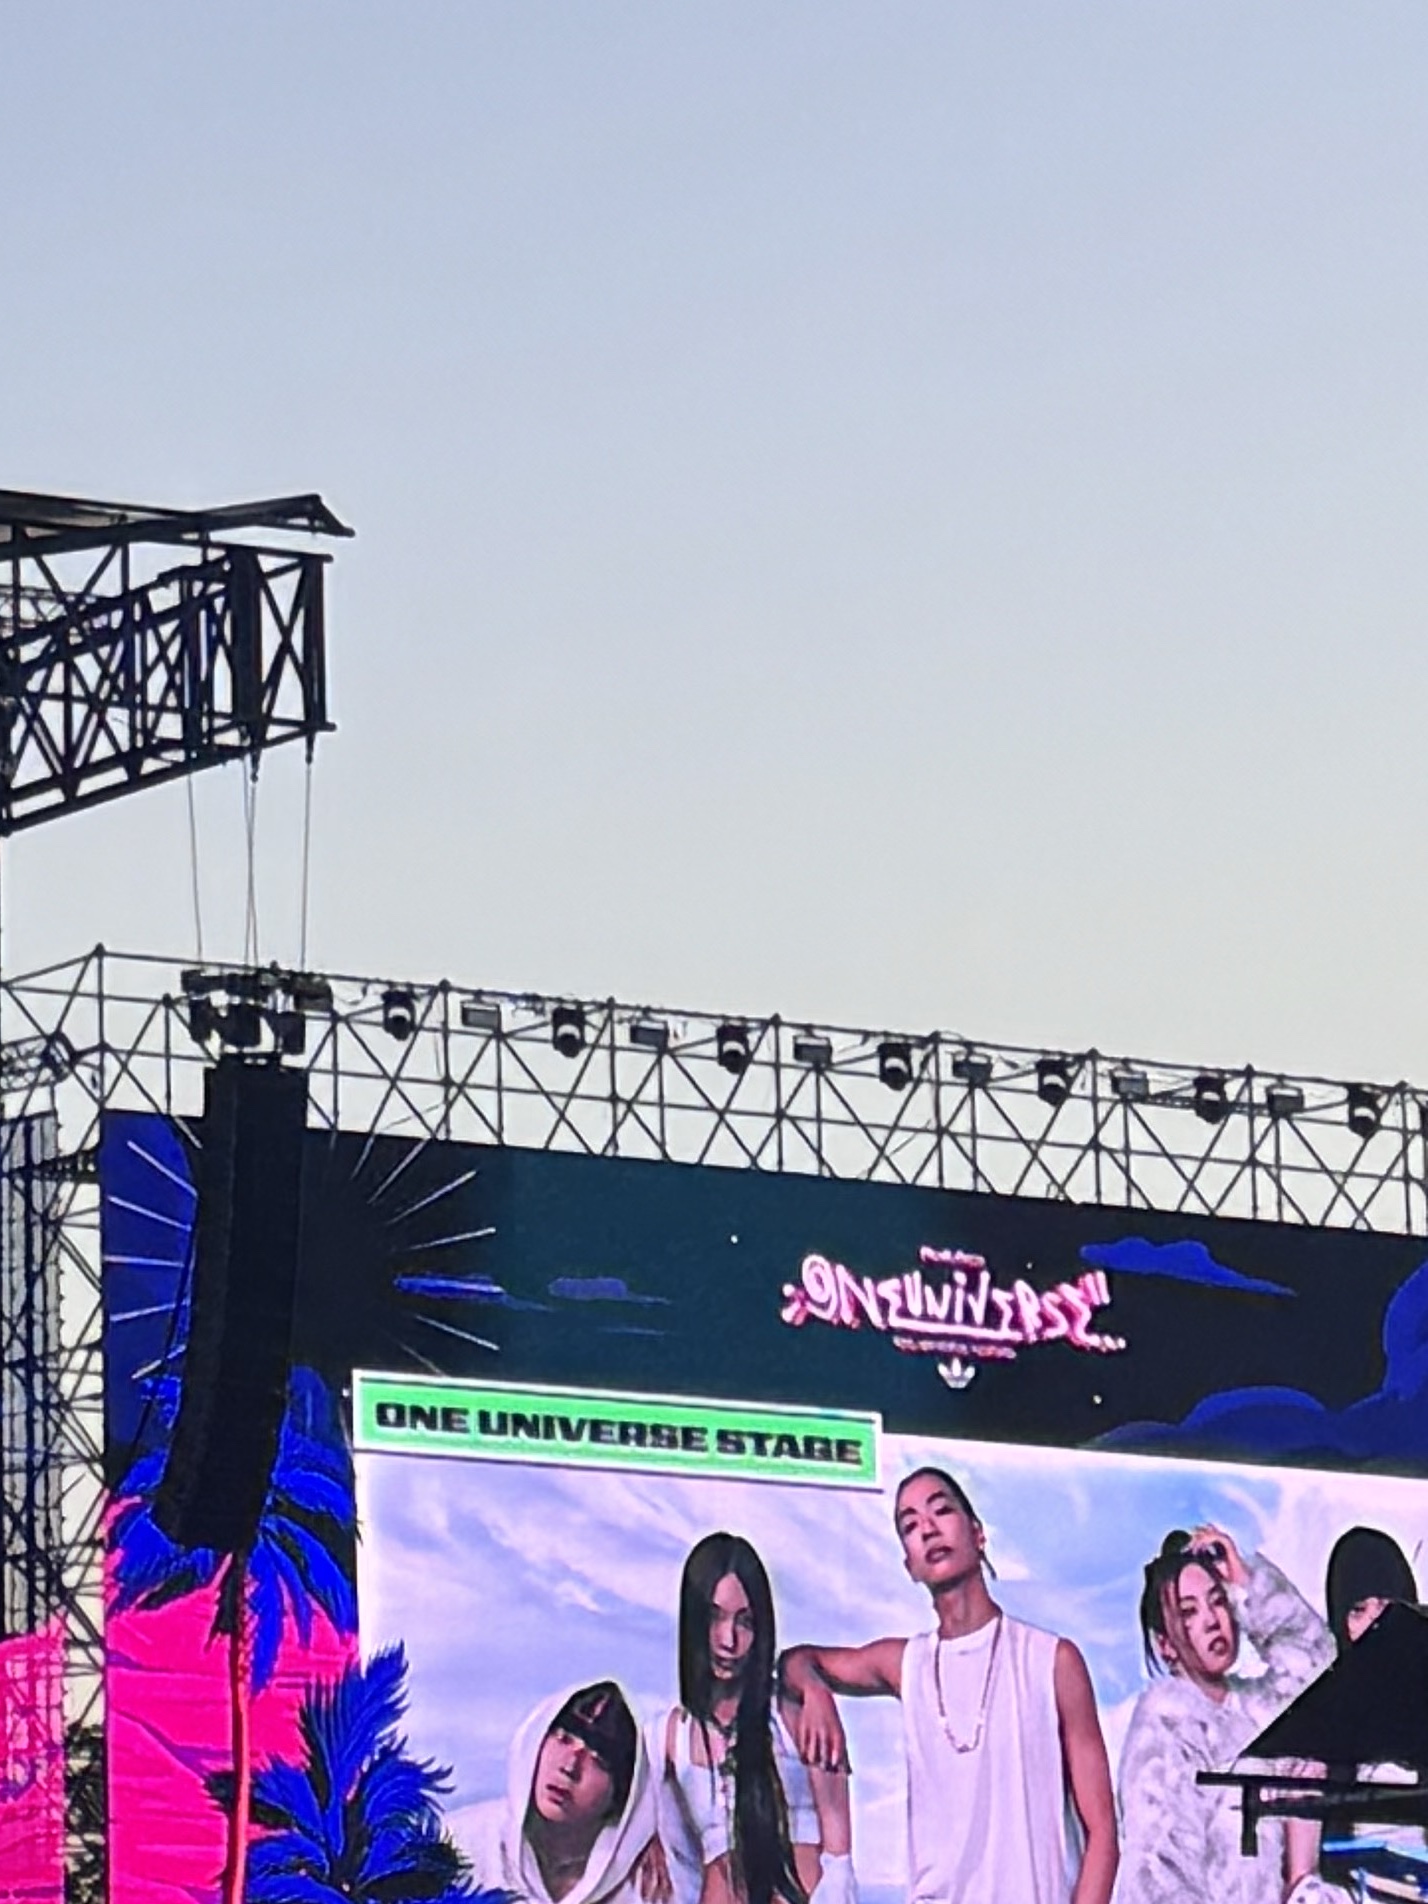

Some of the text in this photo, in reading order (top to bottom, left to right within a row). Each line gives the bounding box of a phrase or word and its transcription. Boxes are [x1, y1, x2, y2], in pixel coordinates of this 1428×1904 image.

[375, 1402, 864, 1466] ONE UNIVERSE STAGE
